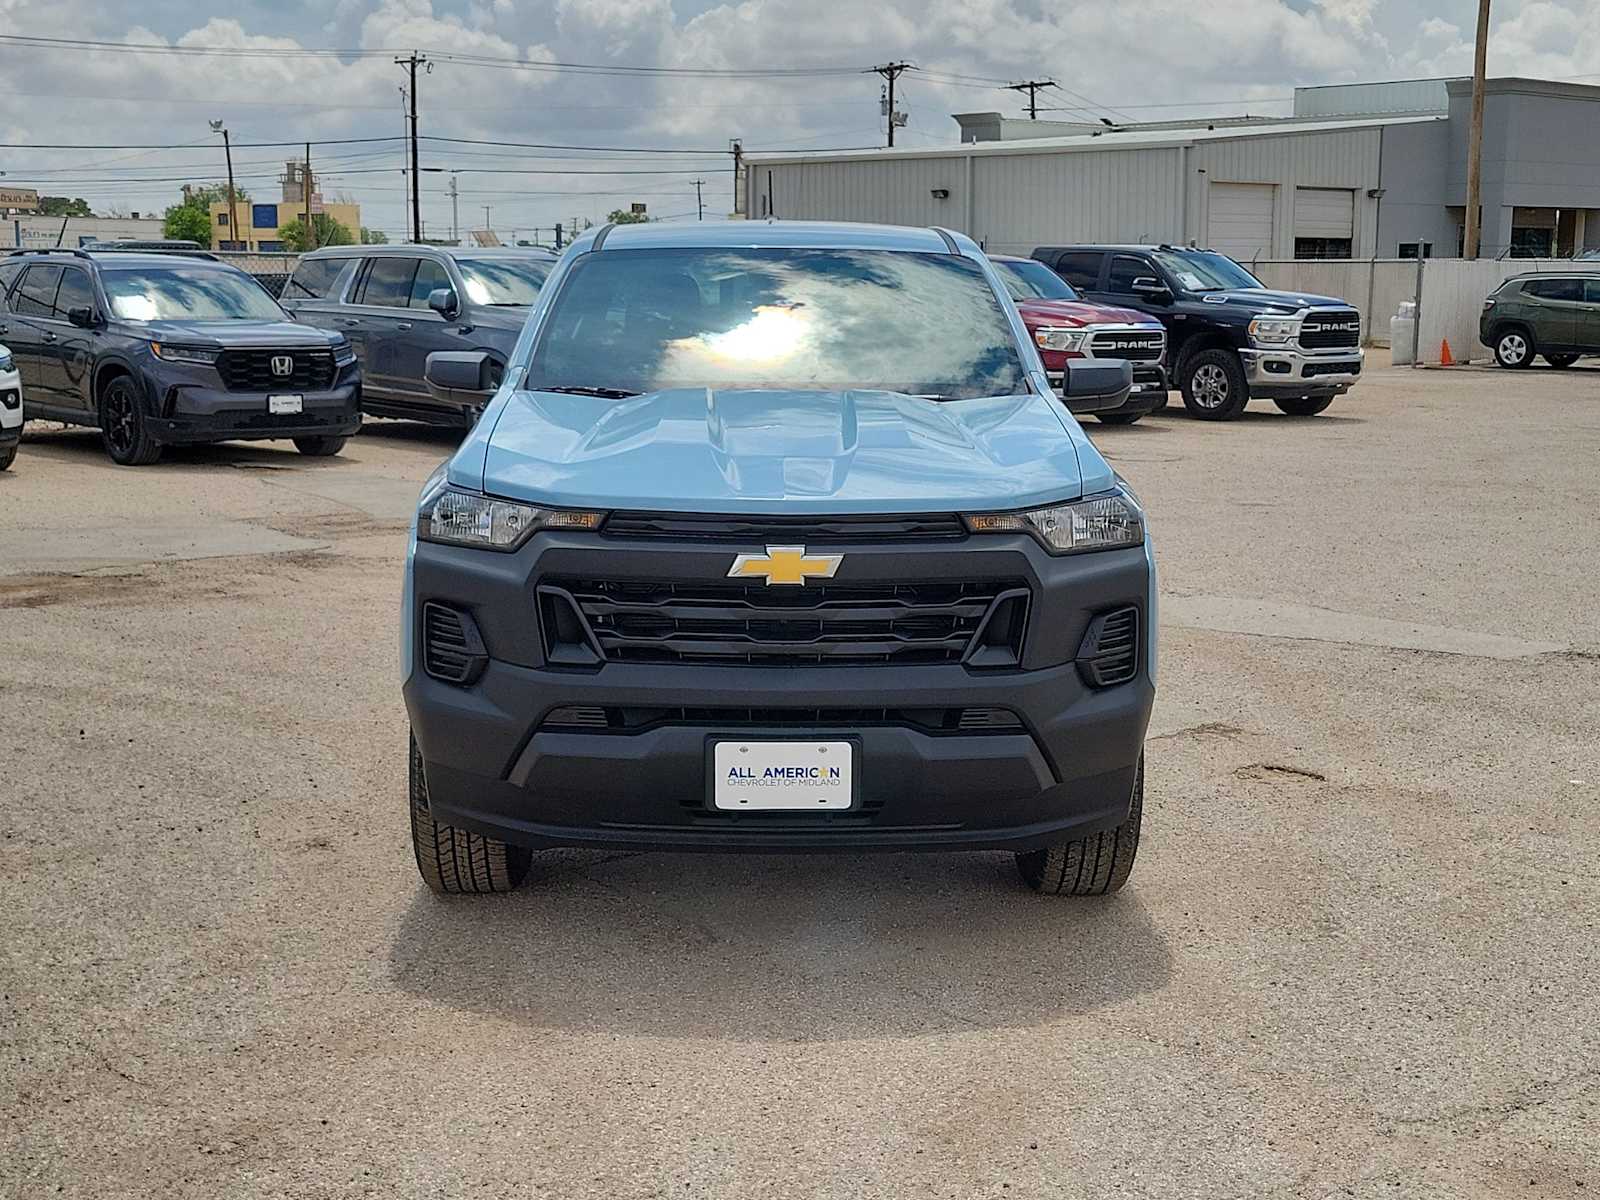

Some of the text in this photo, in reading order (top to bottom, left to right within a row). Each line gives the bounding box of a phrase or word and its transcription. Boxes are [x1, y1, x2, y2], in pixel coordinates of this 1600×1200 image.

[1322, 323, 1350, 331] RAM
[1117, 341, 1148, 349] RAM
[728, 767, 840, 778] ALL AMERICN
[727, 779, 840, 787] CHEVROLET OF MIDLAND
